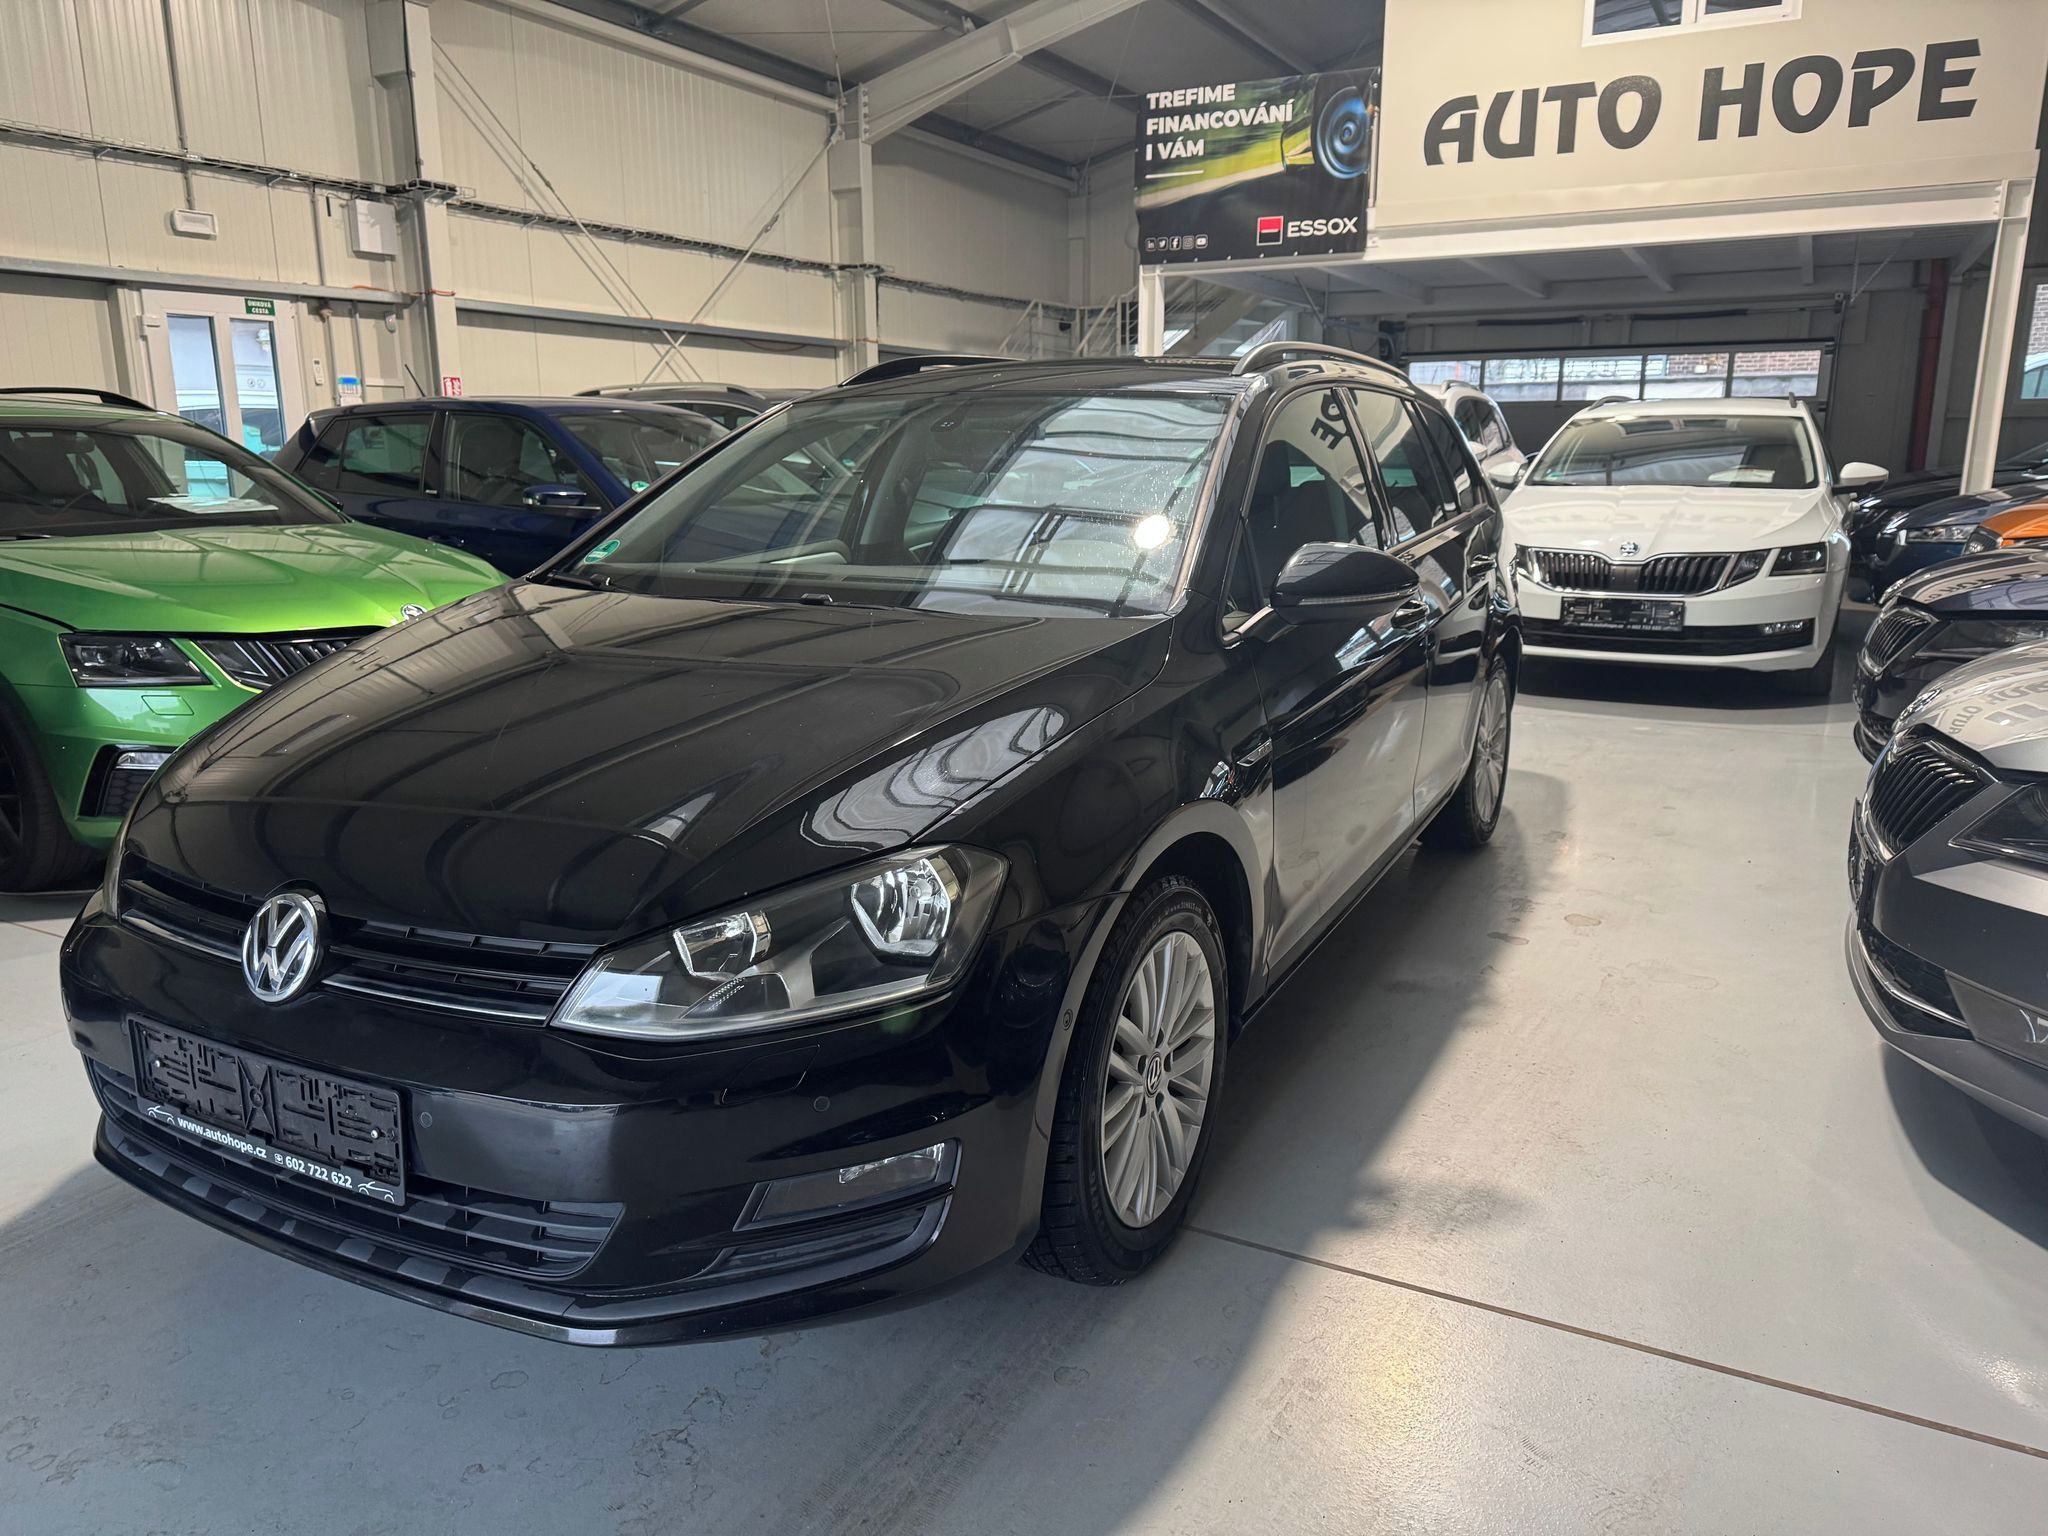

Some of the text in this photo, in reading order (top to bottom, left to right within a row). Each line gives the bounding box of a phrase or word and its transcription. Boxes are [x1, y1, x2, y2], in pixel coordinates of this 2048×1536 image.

[1146, 83, 1236, 110] TREFIME
[1423, 38, 1981, 166] AUTO HOPE
[1146, 99, 1295, 136] FINANCOVÁNÍ
[1145, 136, 1205, 161] I VÁM
[1287, 216, 1358, 238] ESSOX
[177, 1117, 352, 1188] www.autohope.cz 602 722 622
